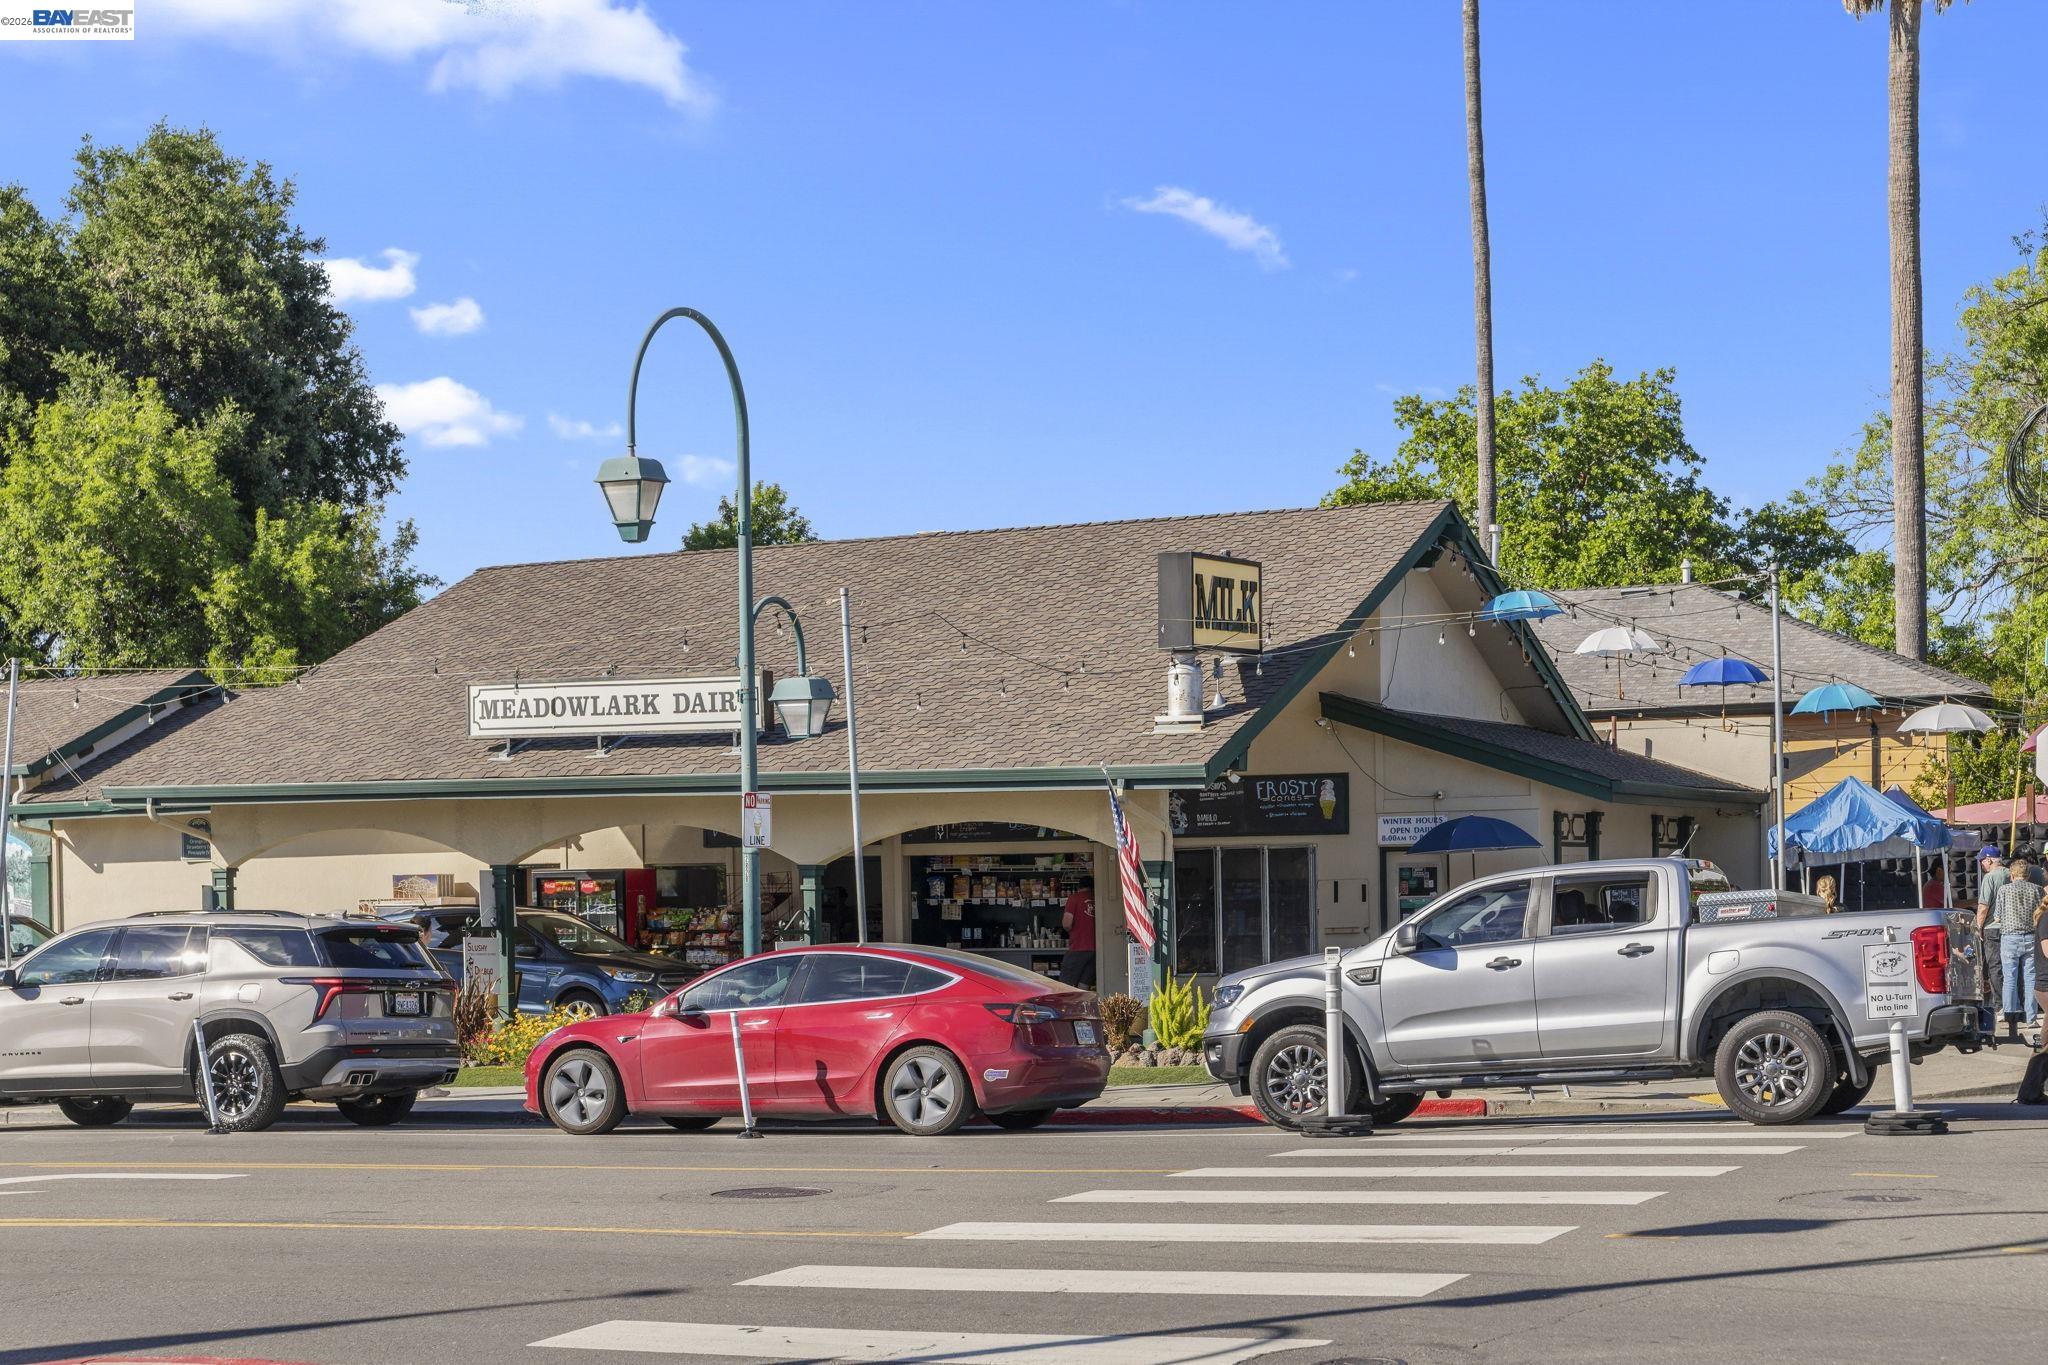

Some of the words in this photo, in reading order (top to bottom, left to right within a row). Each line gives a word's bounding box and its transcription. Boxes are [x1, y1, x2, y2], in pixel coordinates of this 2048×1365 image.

[1195, 573, 1258, 634] MILK
[479, 693, 660, 720] MEADOWLARK
[673, 691, 742, 714] DAIR
[1256, 779, 1318, 799] FROSTY
[745, 795, 756, 808] NO
[1382, 817, 1412, 825] WINTER
[1415, 816, 1444, 824] HOURS
[1390, 826, 1410, 834] OPEN
[749, 835, 766, 845] LINE
[467, 943, 488, 952] SLUSHY
[1886, 993, 1912, 1001] U-Turn
